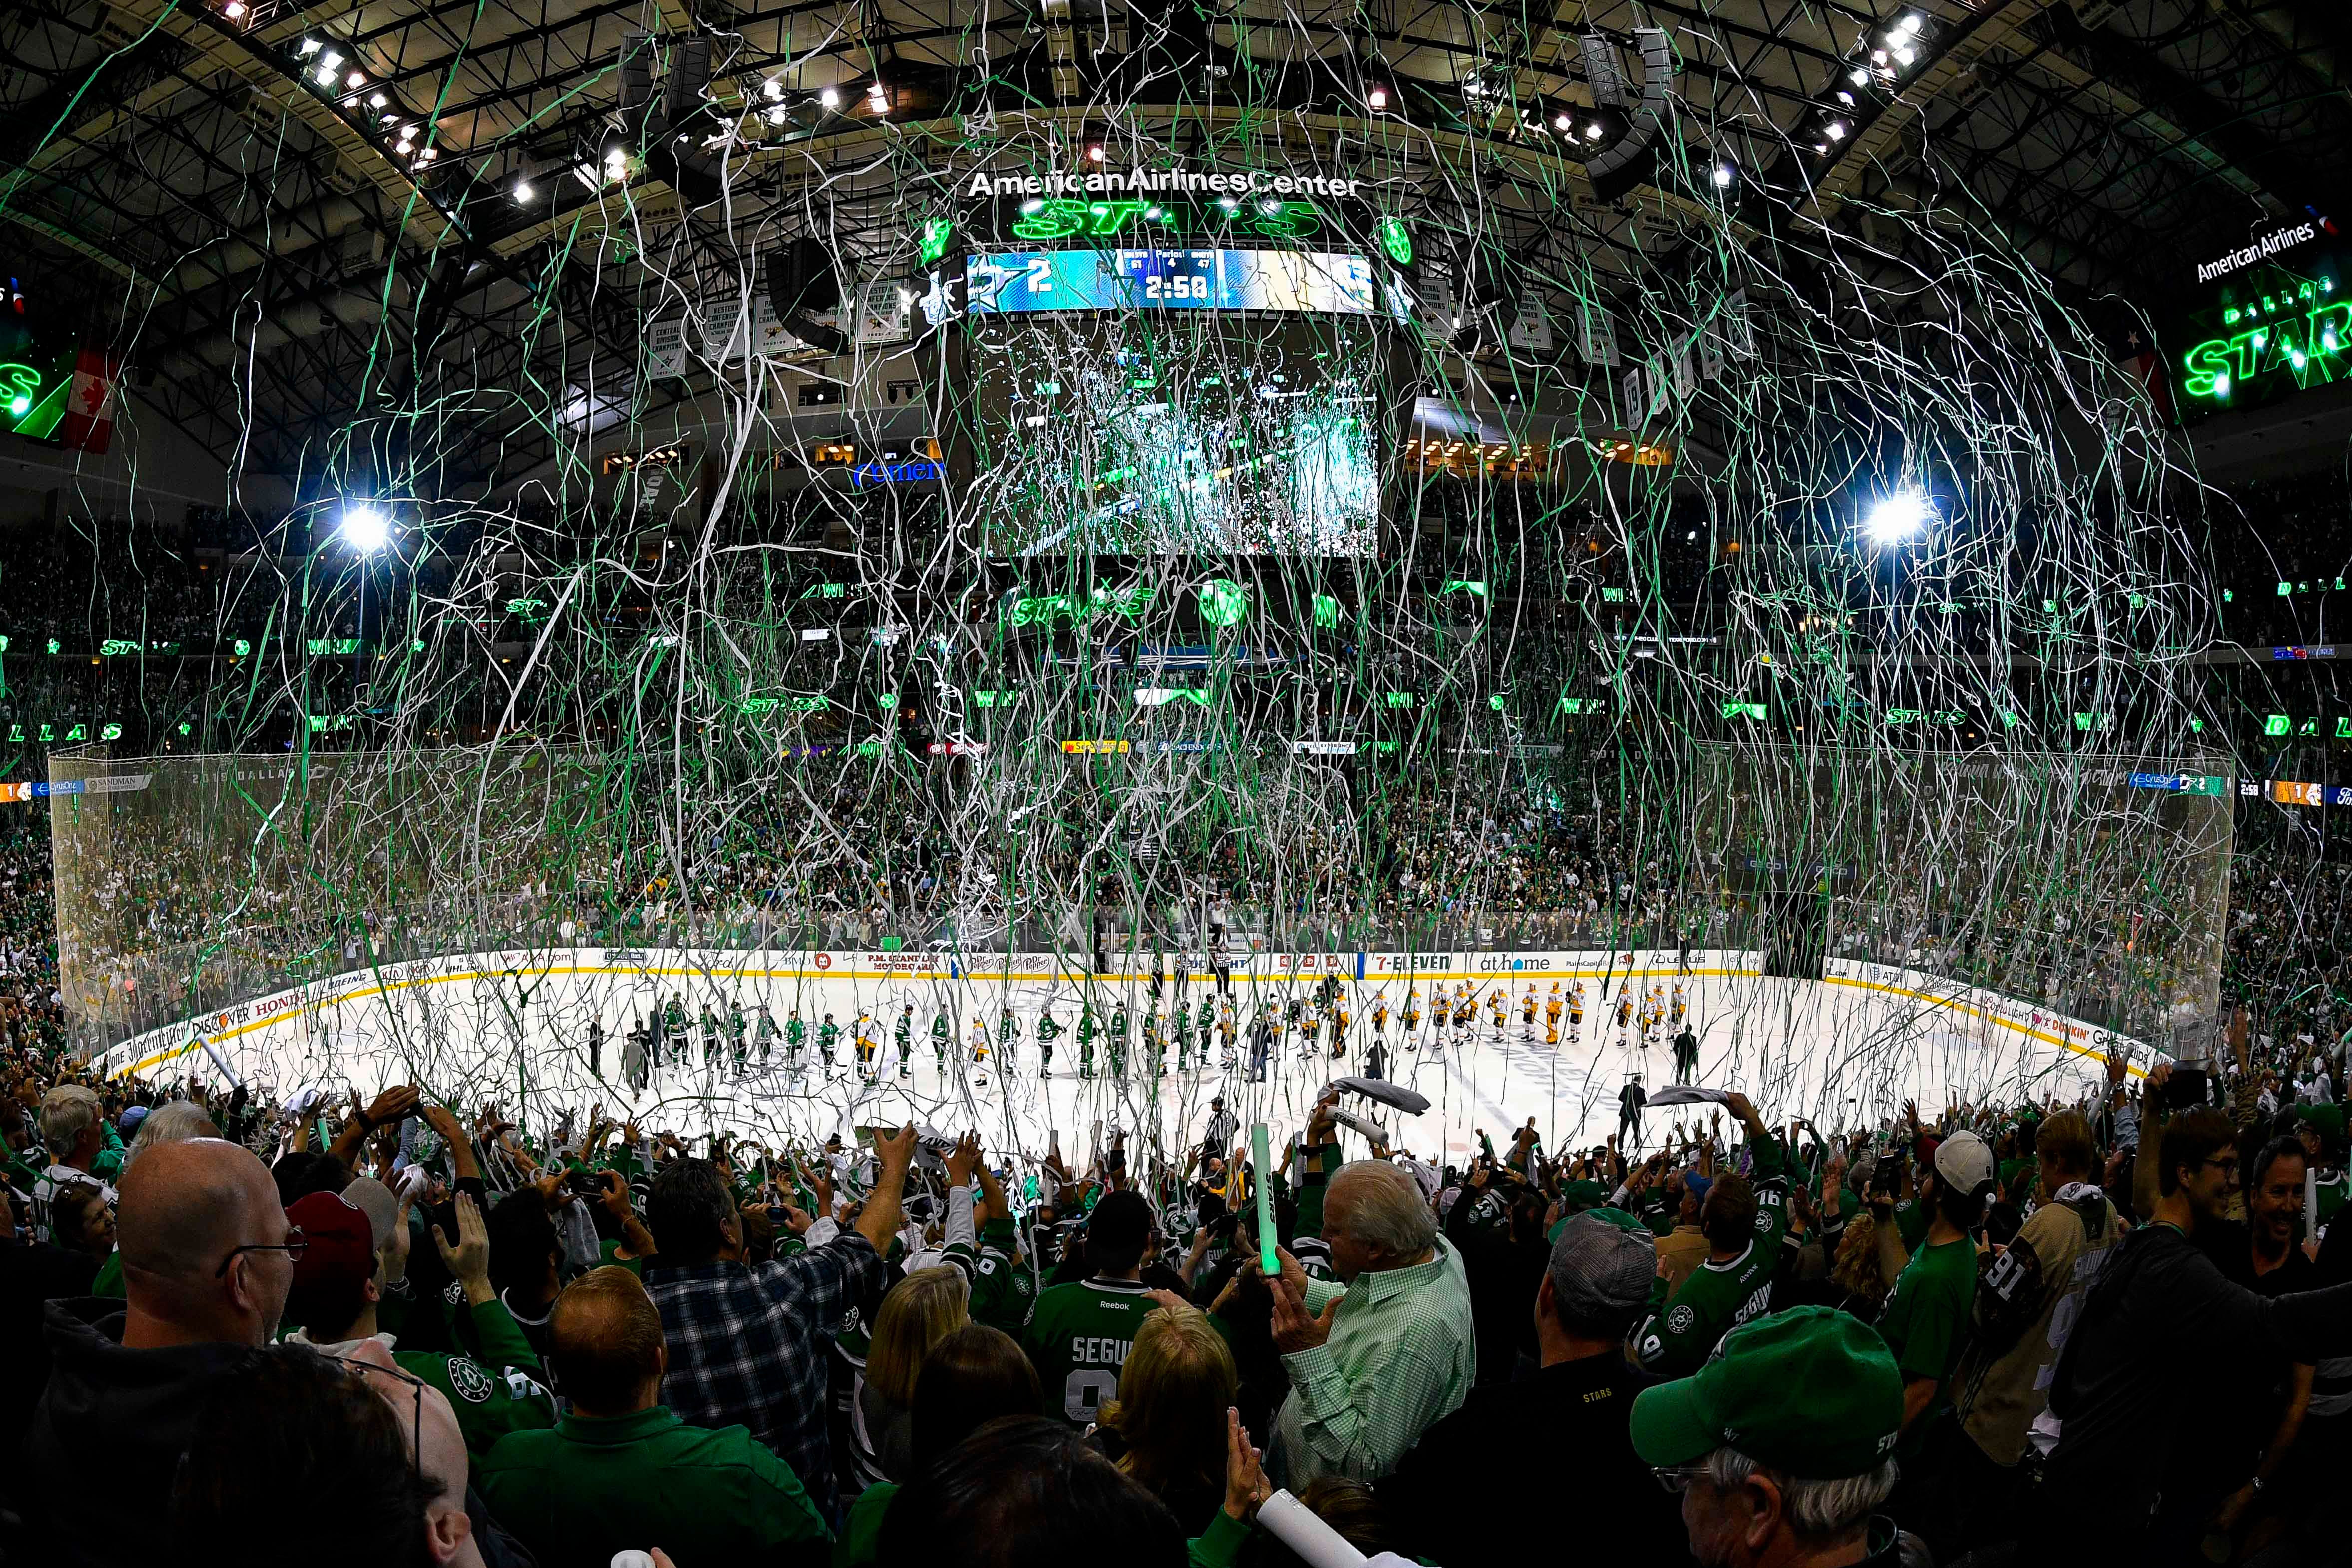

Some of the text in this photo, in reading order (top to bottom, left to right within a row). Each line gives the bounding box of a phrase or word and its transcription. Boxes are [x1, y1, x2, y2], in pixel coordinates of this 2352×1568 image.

[1013, 199, 1325, 237] STARS
[2198, 223, 2315, 283] American Airlines
[1168, 258, 1176, 267] 4
[1027, 259, 1053, 292] 2
[1146, 276, 1208, 299] 2:58
[1421, 284, 1440, 293] NTRAL
[2225, 276, 2332, 324] DALLAS
[2185, 302, 2352, 395] STAR
[1883, 708, 1967, 725] STRS
[7, 785, 13, 797] 1
[2241, 784, 2258, 796] 2:58
[2295, 784, 2301, 798] 1
[2337, 787, 2352, 801] Fo
[1023, 957, 1048, 970] Pepper
[1332, 1112, 1358, 1128] STARS
[1265, 1172, 1276, 1224] STARS
[1985, 1250, 2026, 1301] 91
[1100, 1301, 1130, 1311] Reebok
[1583, 1388, 1612, 1403] STARS
